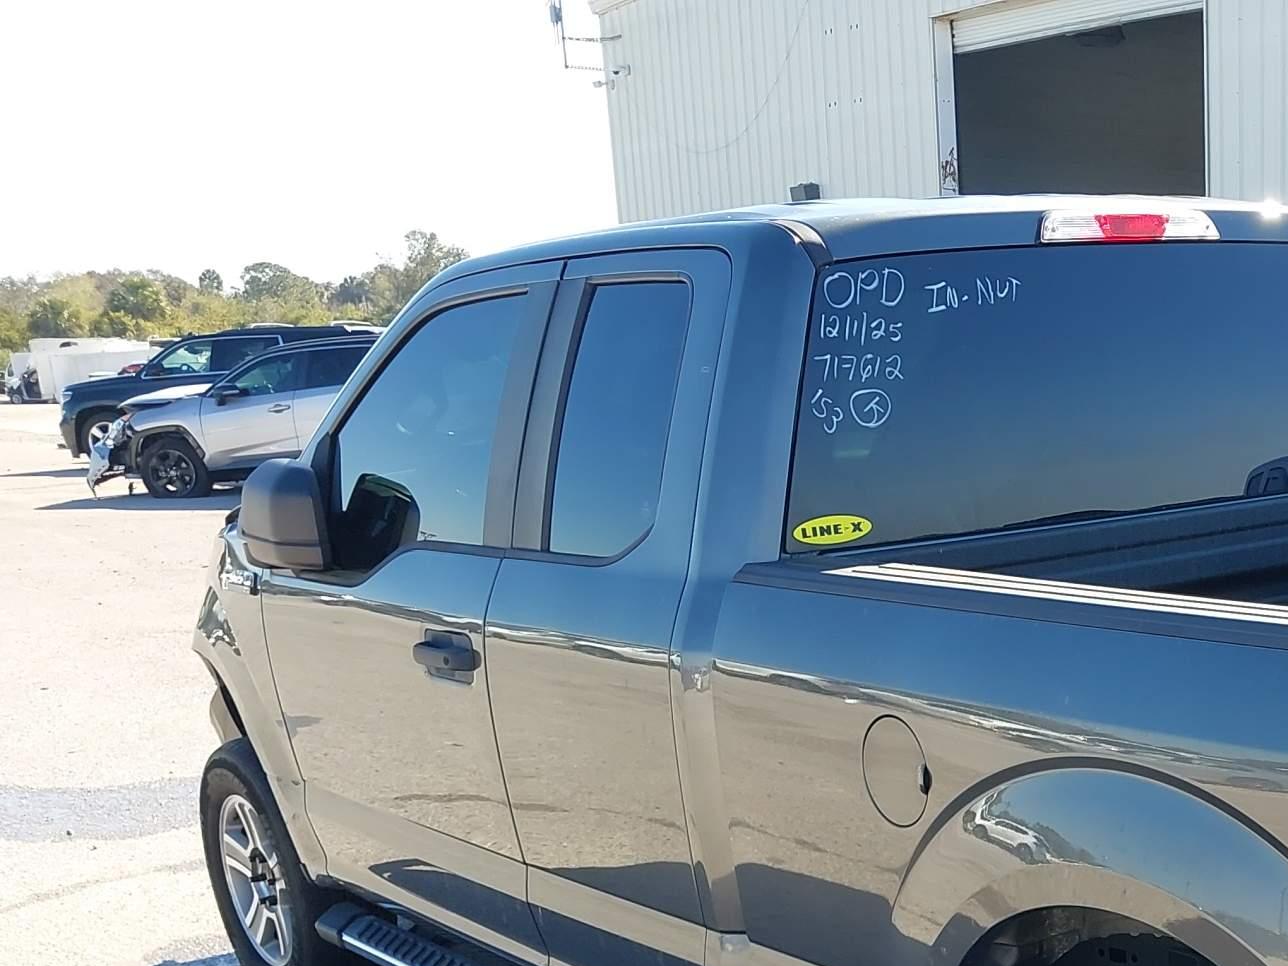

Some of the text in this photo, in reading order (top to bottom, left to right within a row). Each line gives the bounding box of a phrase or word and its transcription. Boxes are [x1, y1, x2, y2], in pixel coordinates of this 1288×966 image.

[823, 267, 904, 308] OPD
[813, 354, 904, 383] 717612
[800, 521, 864, 540] LINE-X
